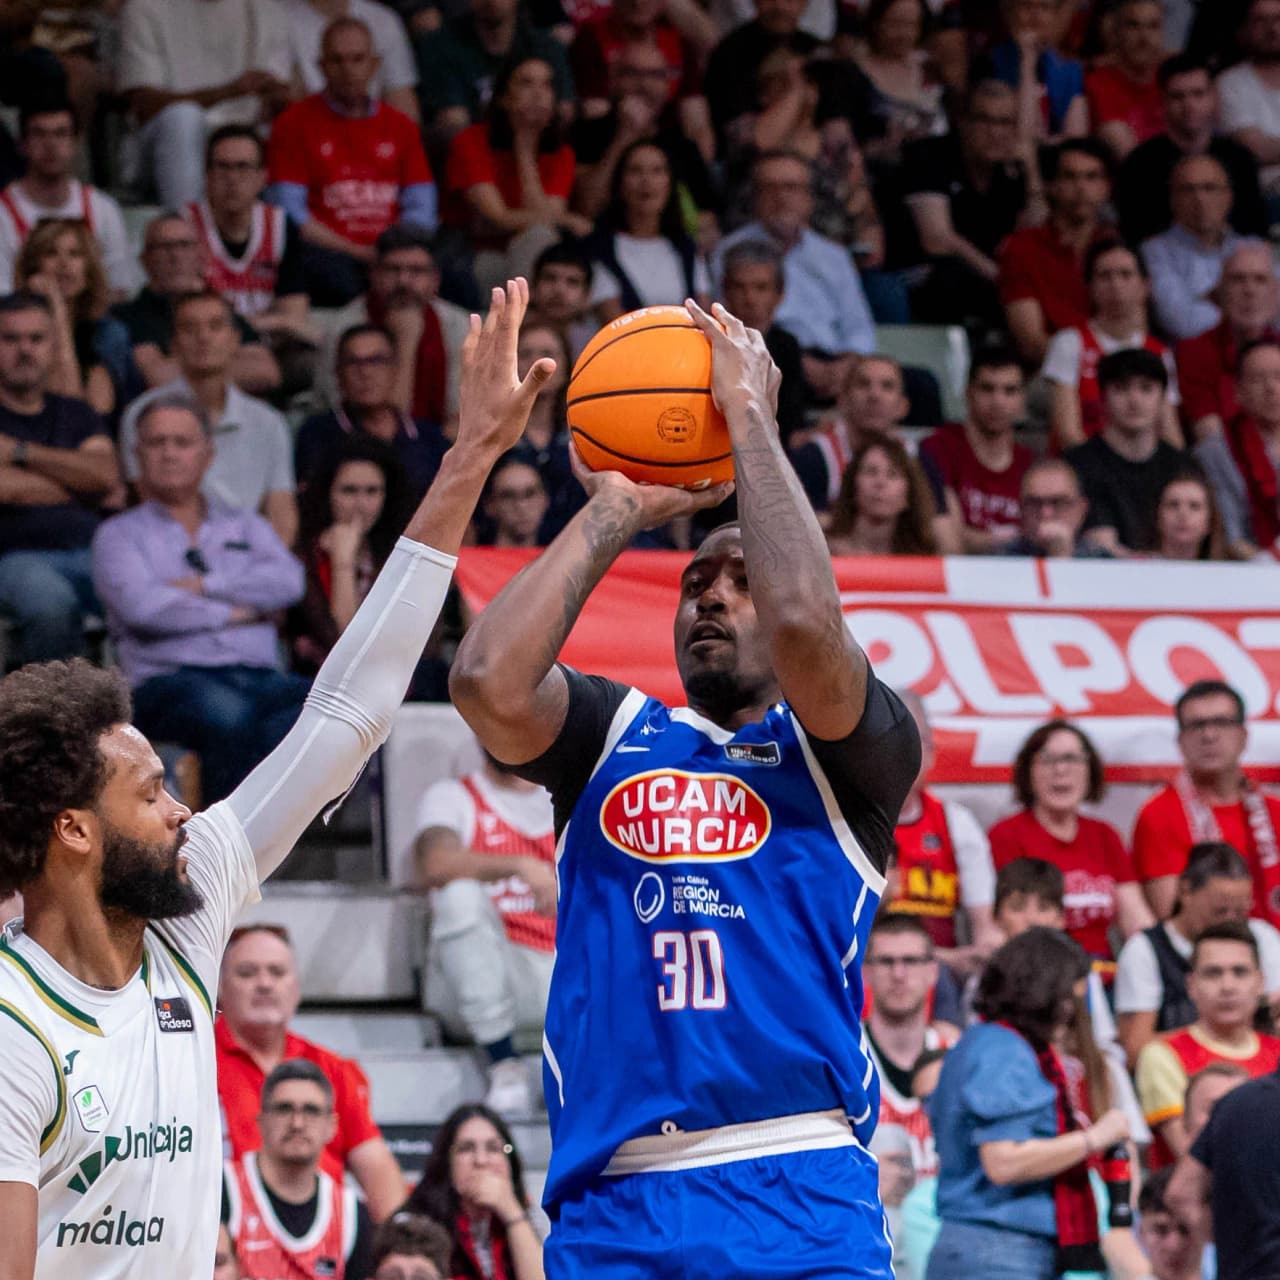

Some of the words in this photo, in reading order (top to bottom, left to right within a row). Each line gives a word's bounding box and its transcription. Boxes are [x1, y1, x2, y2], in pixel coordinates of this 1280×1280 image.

[622, 776, 747, 818] UCAM
[616, 817, 758, 854] MURCIA
[673, 885, 720, 903] REGIÓN
[673, 900, 687, 914] DE
[689, 899, 746, 920] MURCIA
[652, 929, 727, 1011] 30
